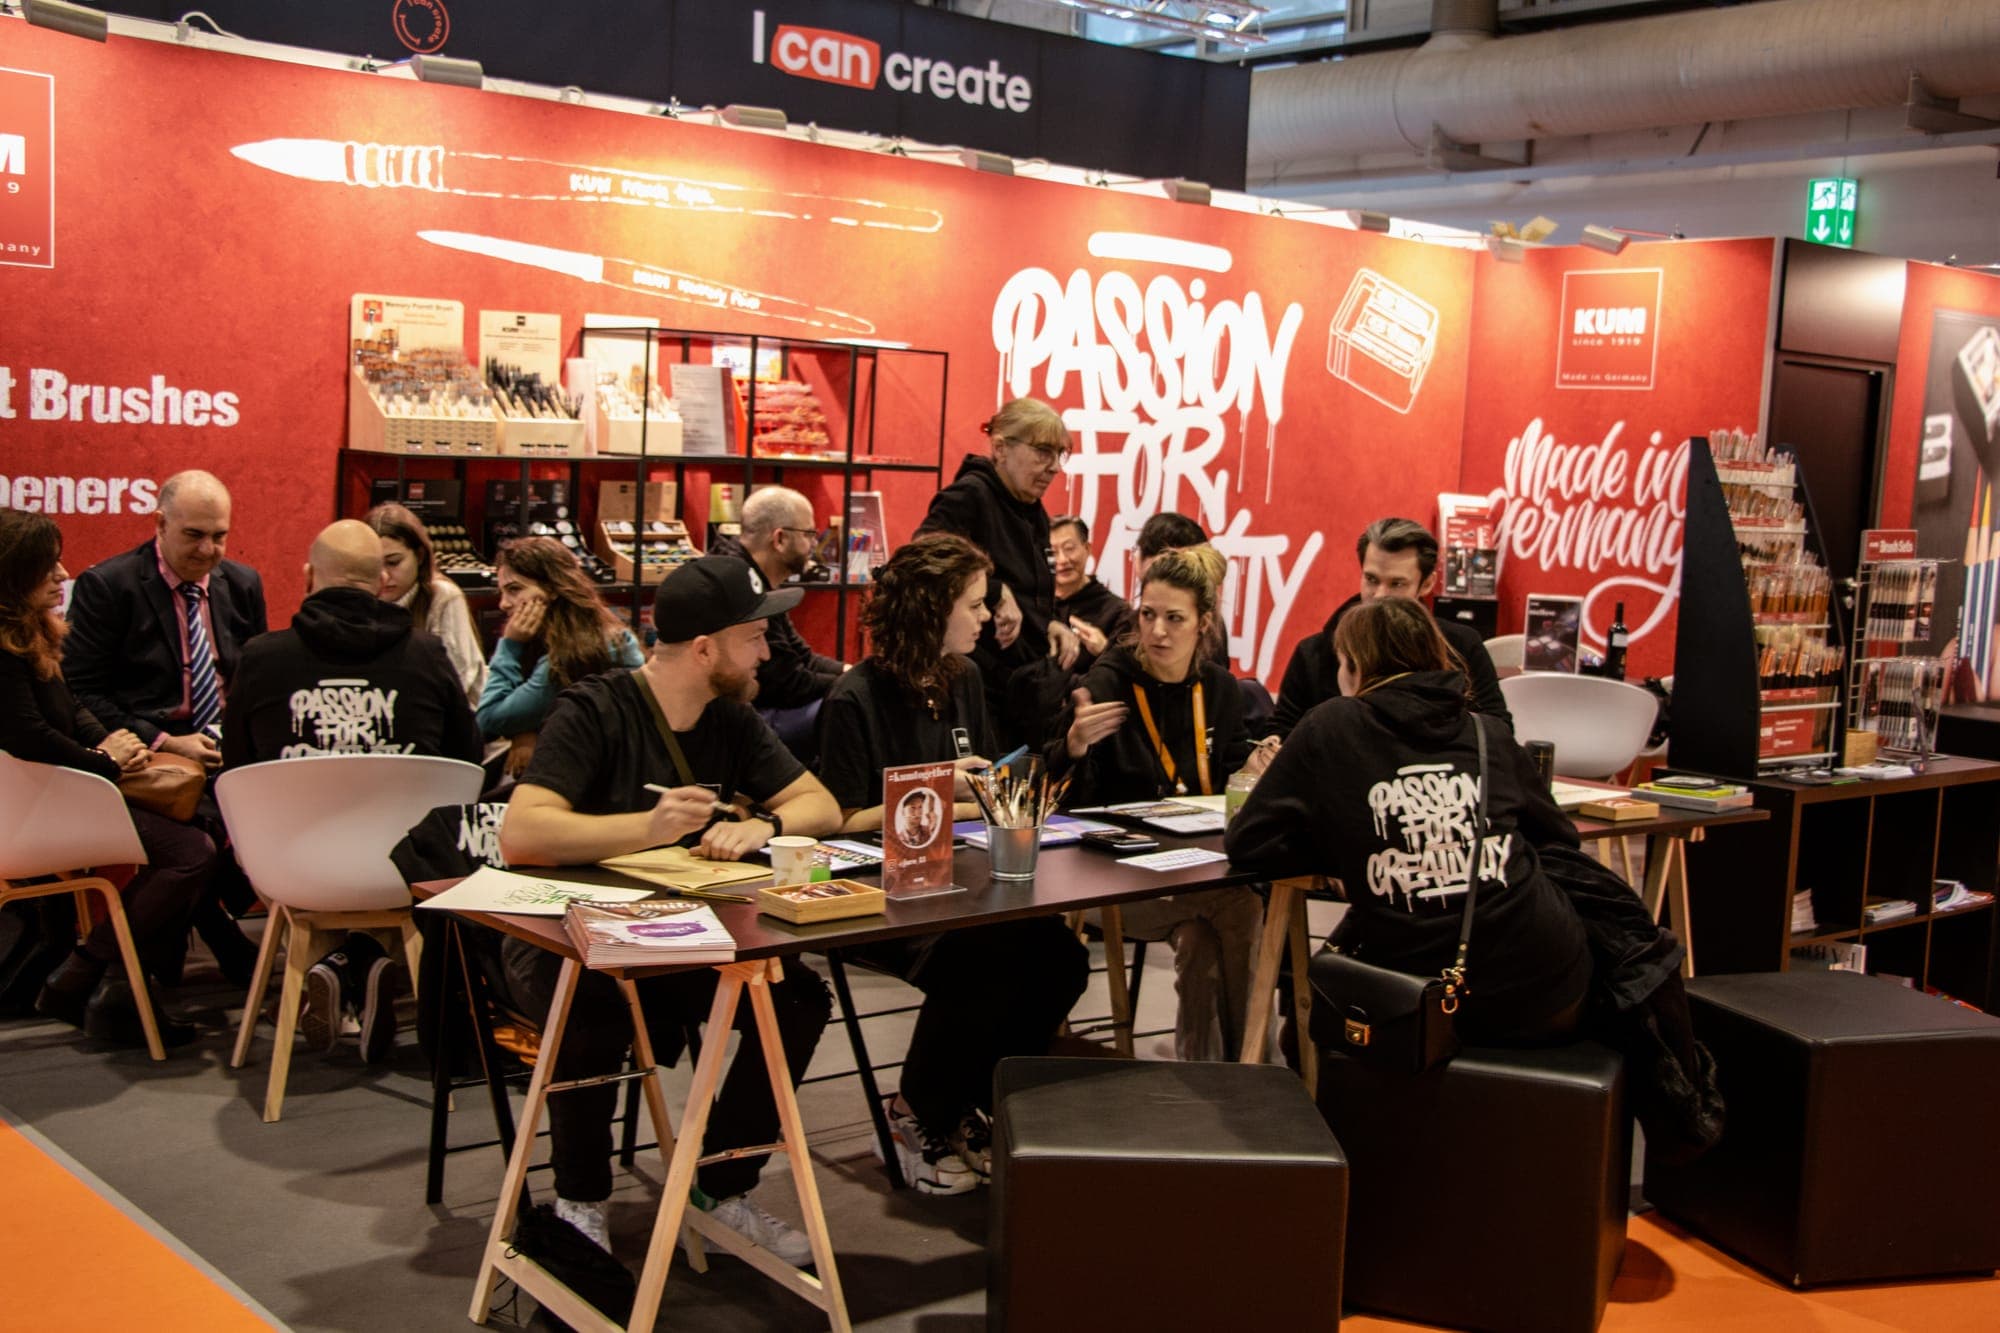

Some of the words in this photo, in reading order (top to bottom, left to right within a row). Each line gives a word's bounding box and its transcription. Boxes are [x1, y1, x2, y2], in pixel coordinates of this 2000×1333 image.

[753, 10, 765, 64] I
[778, 32, 871, 84] can
[884, 52, 1032, 113] create
[1572, 338, 1603, 347] since
[1611, 337, 1641, 346] 1919
[1573, 307, 1647, 335] KUM
[30, 368, 240, 427] Brushes
